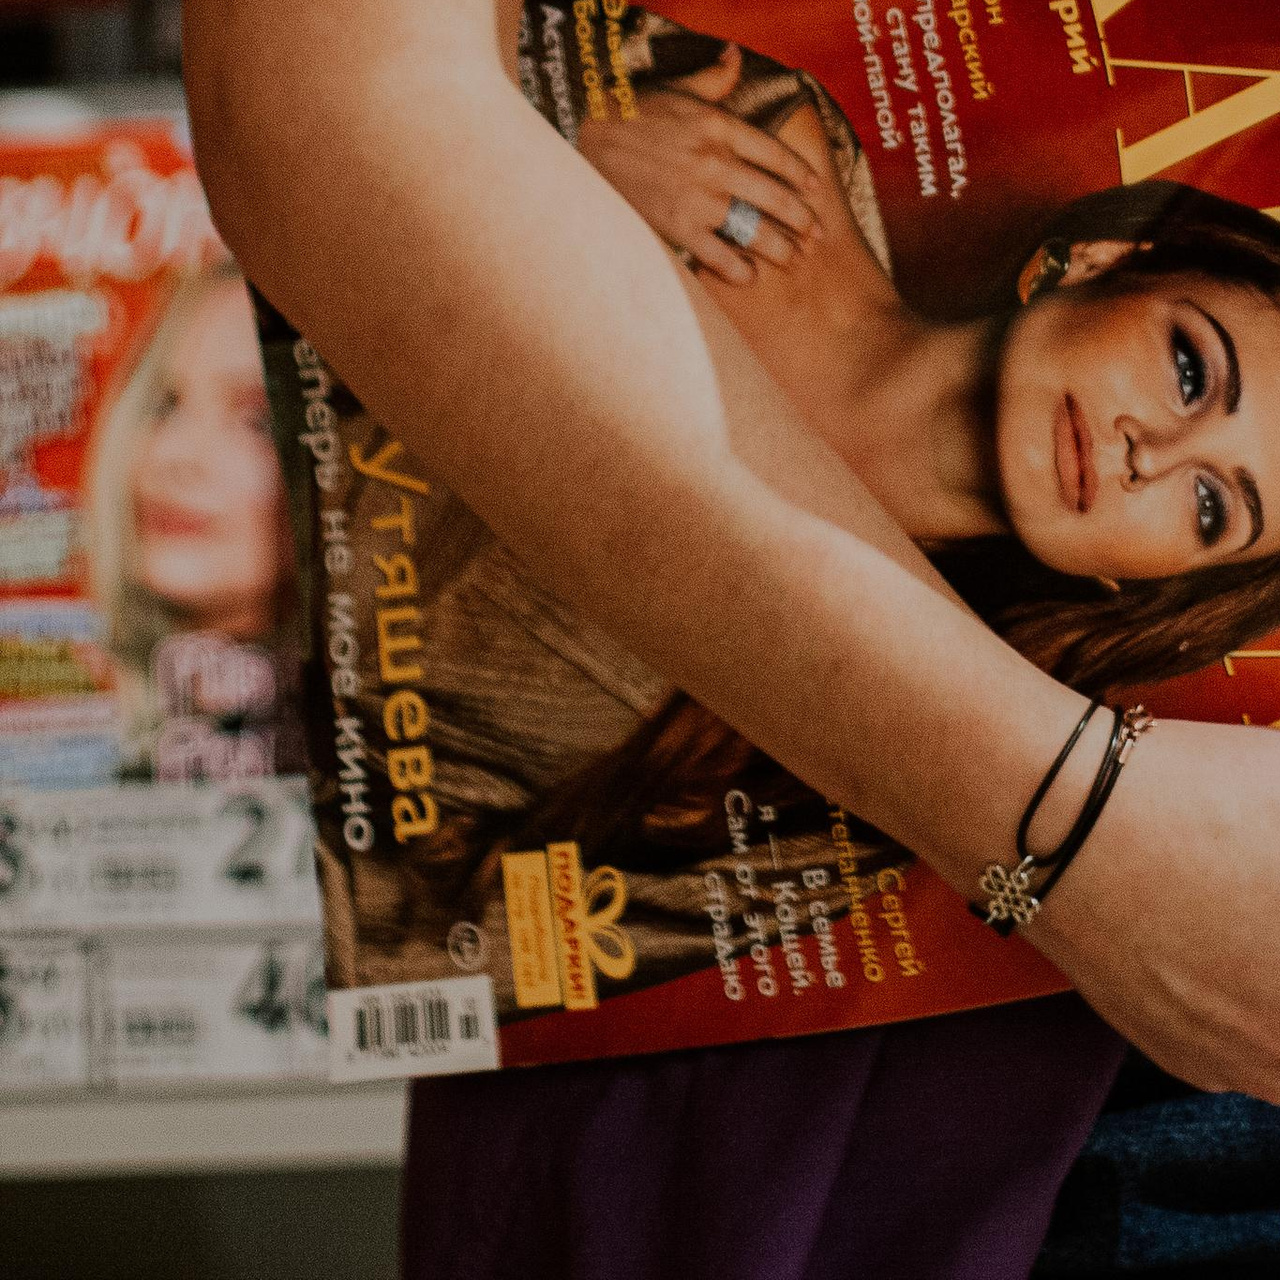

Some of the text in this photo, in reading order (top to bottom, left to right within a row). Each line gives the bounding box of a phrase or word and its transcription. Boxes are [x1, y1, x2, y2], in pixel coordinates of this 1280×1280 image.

[885, 6, 918, 92] стану
[907, 101, 938, 198] таким
[290, 338, 335, 490] еперь
[319, 507, 346, 578] не
[334, 714, 375, 855] кино
[347, 437, 438, 845] Утяшева
[723, 789, 778, 999] Сам от этого
[756, 805, 778, 824] я
[827, 806, 884, 984] тепанченко
[701, 870, 745, 1003] страдаю
[800, 866, 845, 989] В семье
[875, 868, 926, 977] Сергей
